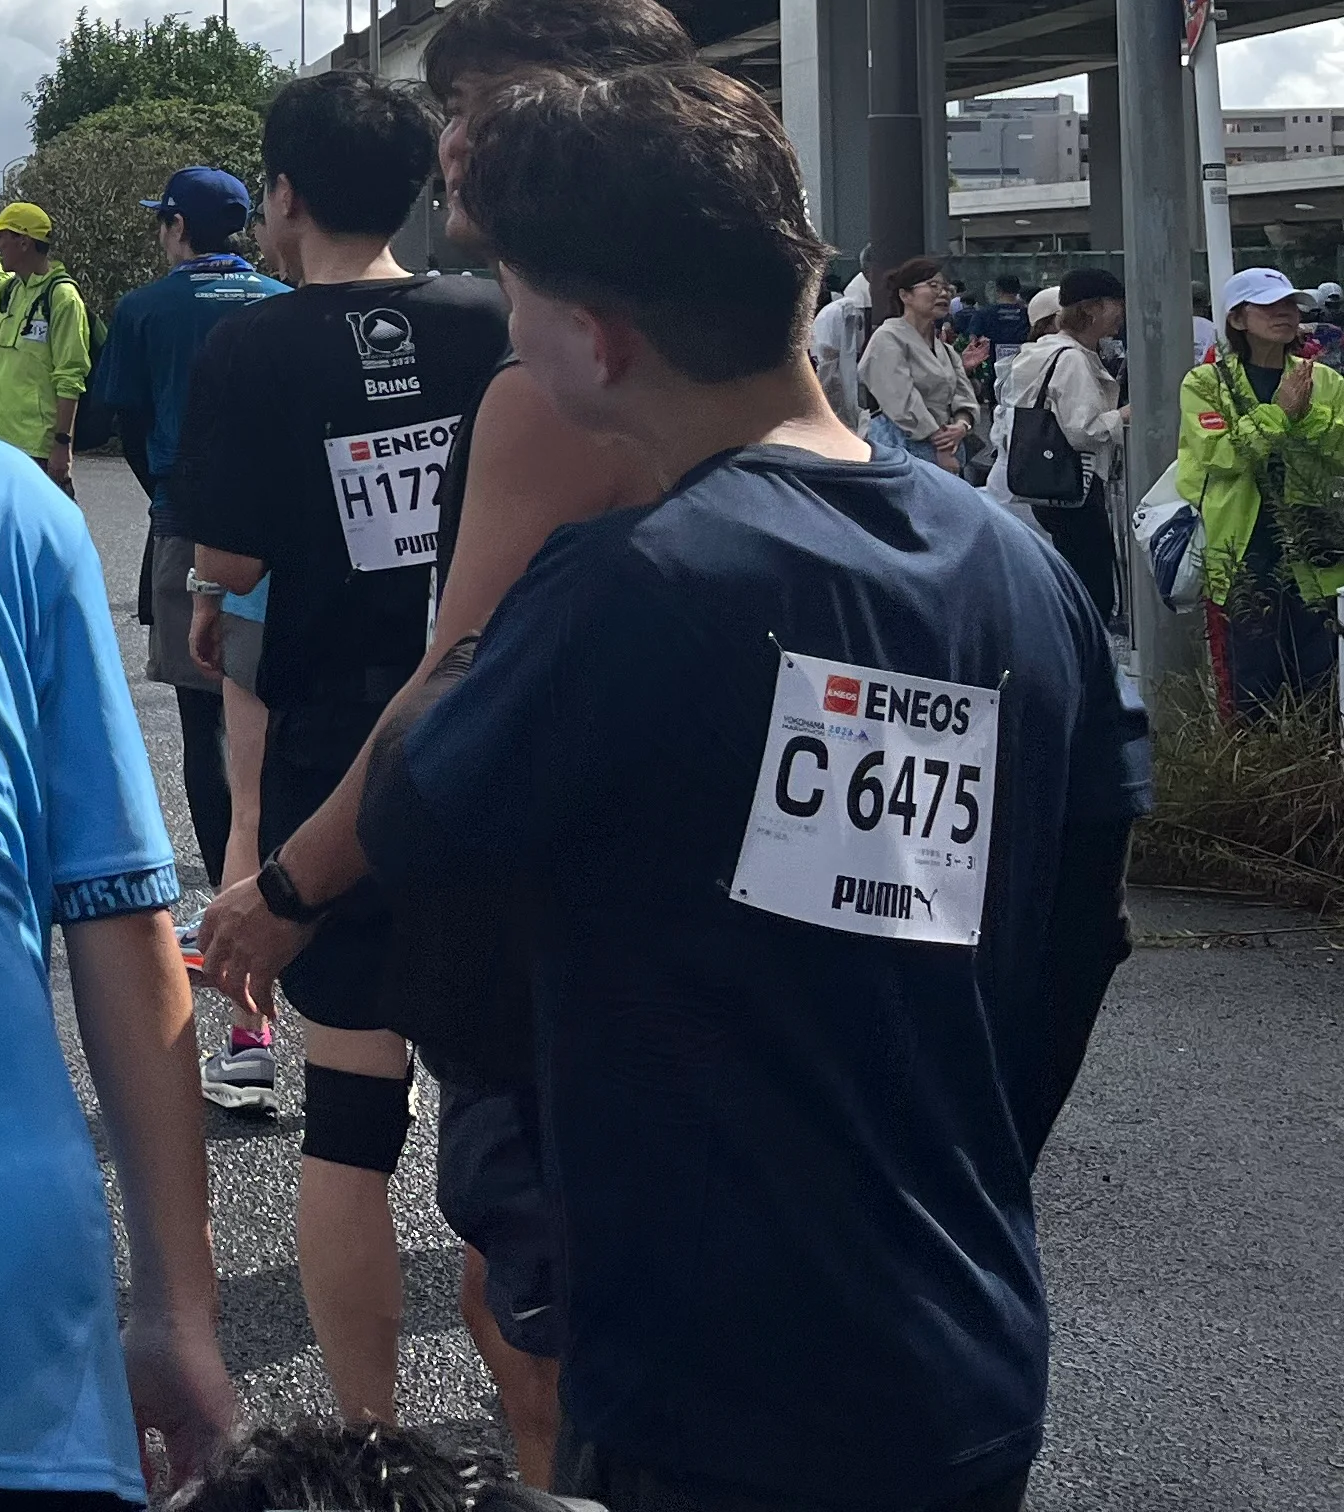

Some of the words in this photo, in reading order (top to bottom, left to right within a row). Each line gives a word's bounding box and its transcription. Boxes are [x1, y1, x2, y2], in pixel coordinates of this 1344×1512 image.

[364, 375, 421, 396] BRING
[864, 681, 972, 736] ENEOS
[775, 735, 830, 818] C
[846, 750, 982, 845] 6475
[831, 874, 914, 920] PUMA
